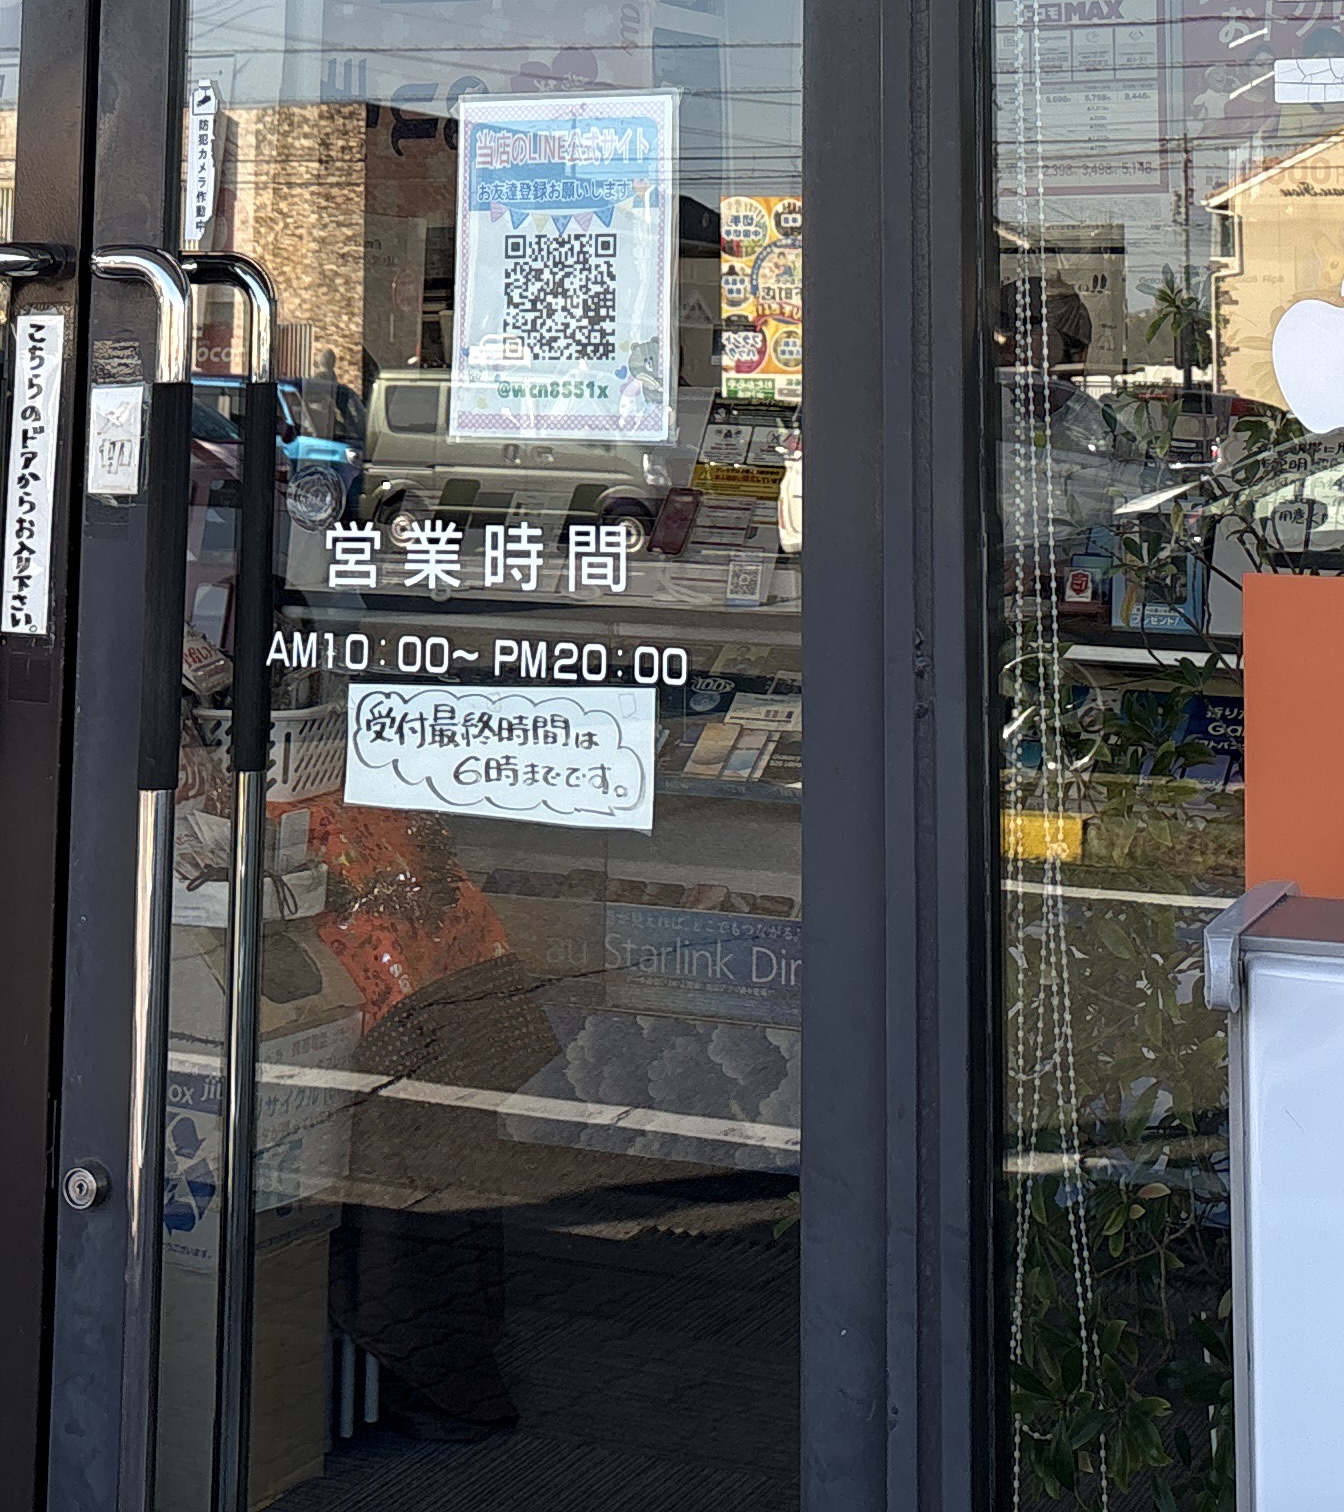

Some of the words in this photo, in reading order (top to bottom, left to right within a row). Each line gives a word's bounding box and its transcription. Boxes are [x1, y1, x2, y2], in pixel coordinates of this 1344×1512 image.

[1064, 0, 1125, 23] MAX
[475, 126, 651, 170] 当店のLINE公式サイト
[195, 119, 209, 233] 防犯カメラ作動中
[477, 178, 632, 203] お友達登録お願いします
[9, 324, 46, 633] こちらのドアからお入り下さい。
[324, 519, 630, 593] 営業時間
[363, 703, 601, 750] 受付最終時間は
[1207, 722, 1245, 737] Ga
[453, 755, 629, 799] 6時までです。
[605, 932, 736, 981] Starlink
